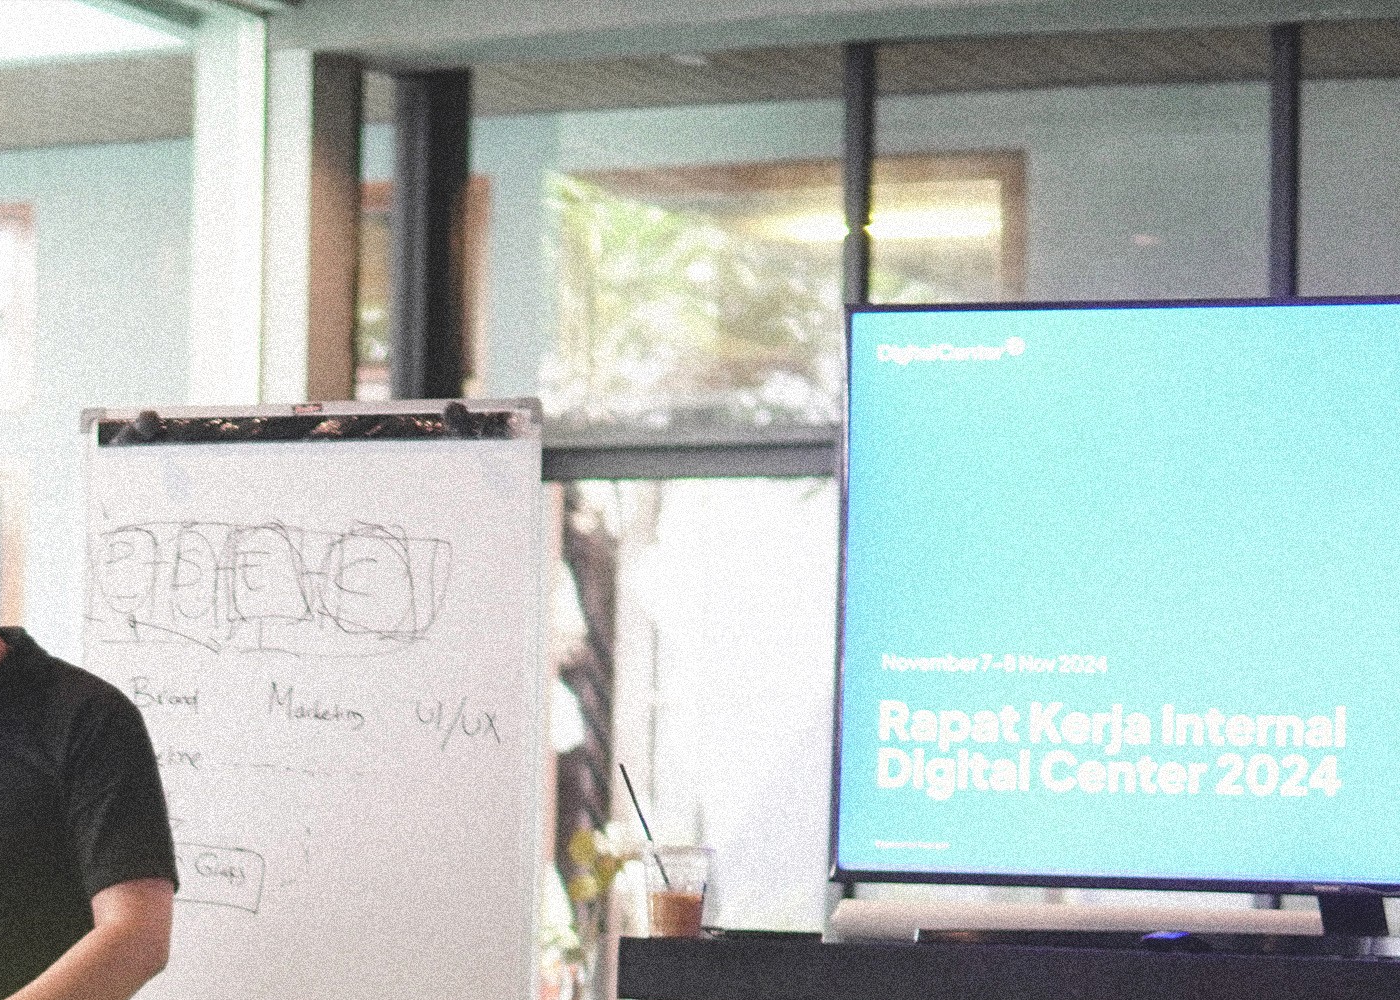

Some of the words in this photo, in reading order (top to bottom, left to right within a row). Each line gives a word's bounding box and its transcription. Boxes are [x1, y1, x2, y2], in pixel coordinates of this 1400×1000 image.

[881, 653, 979, 673] November
[1018, 654, 1056, 674] Nov
[1058, 654, 1108, 675] 2024
[415, 696, 502, 751] UI/UX
[877, 699, 1021, 753] Rapat
[1029, 702, 1153, 756] Kerja
[1161, 703, 1348, 749] Internal
[875, 747, 1031, 802] Digital
[1039, 750, 1209, 796] Center
[1215, 752, 1344, 798] 2024
